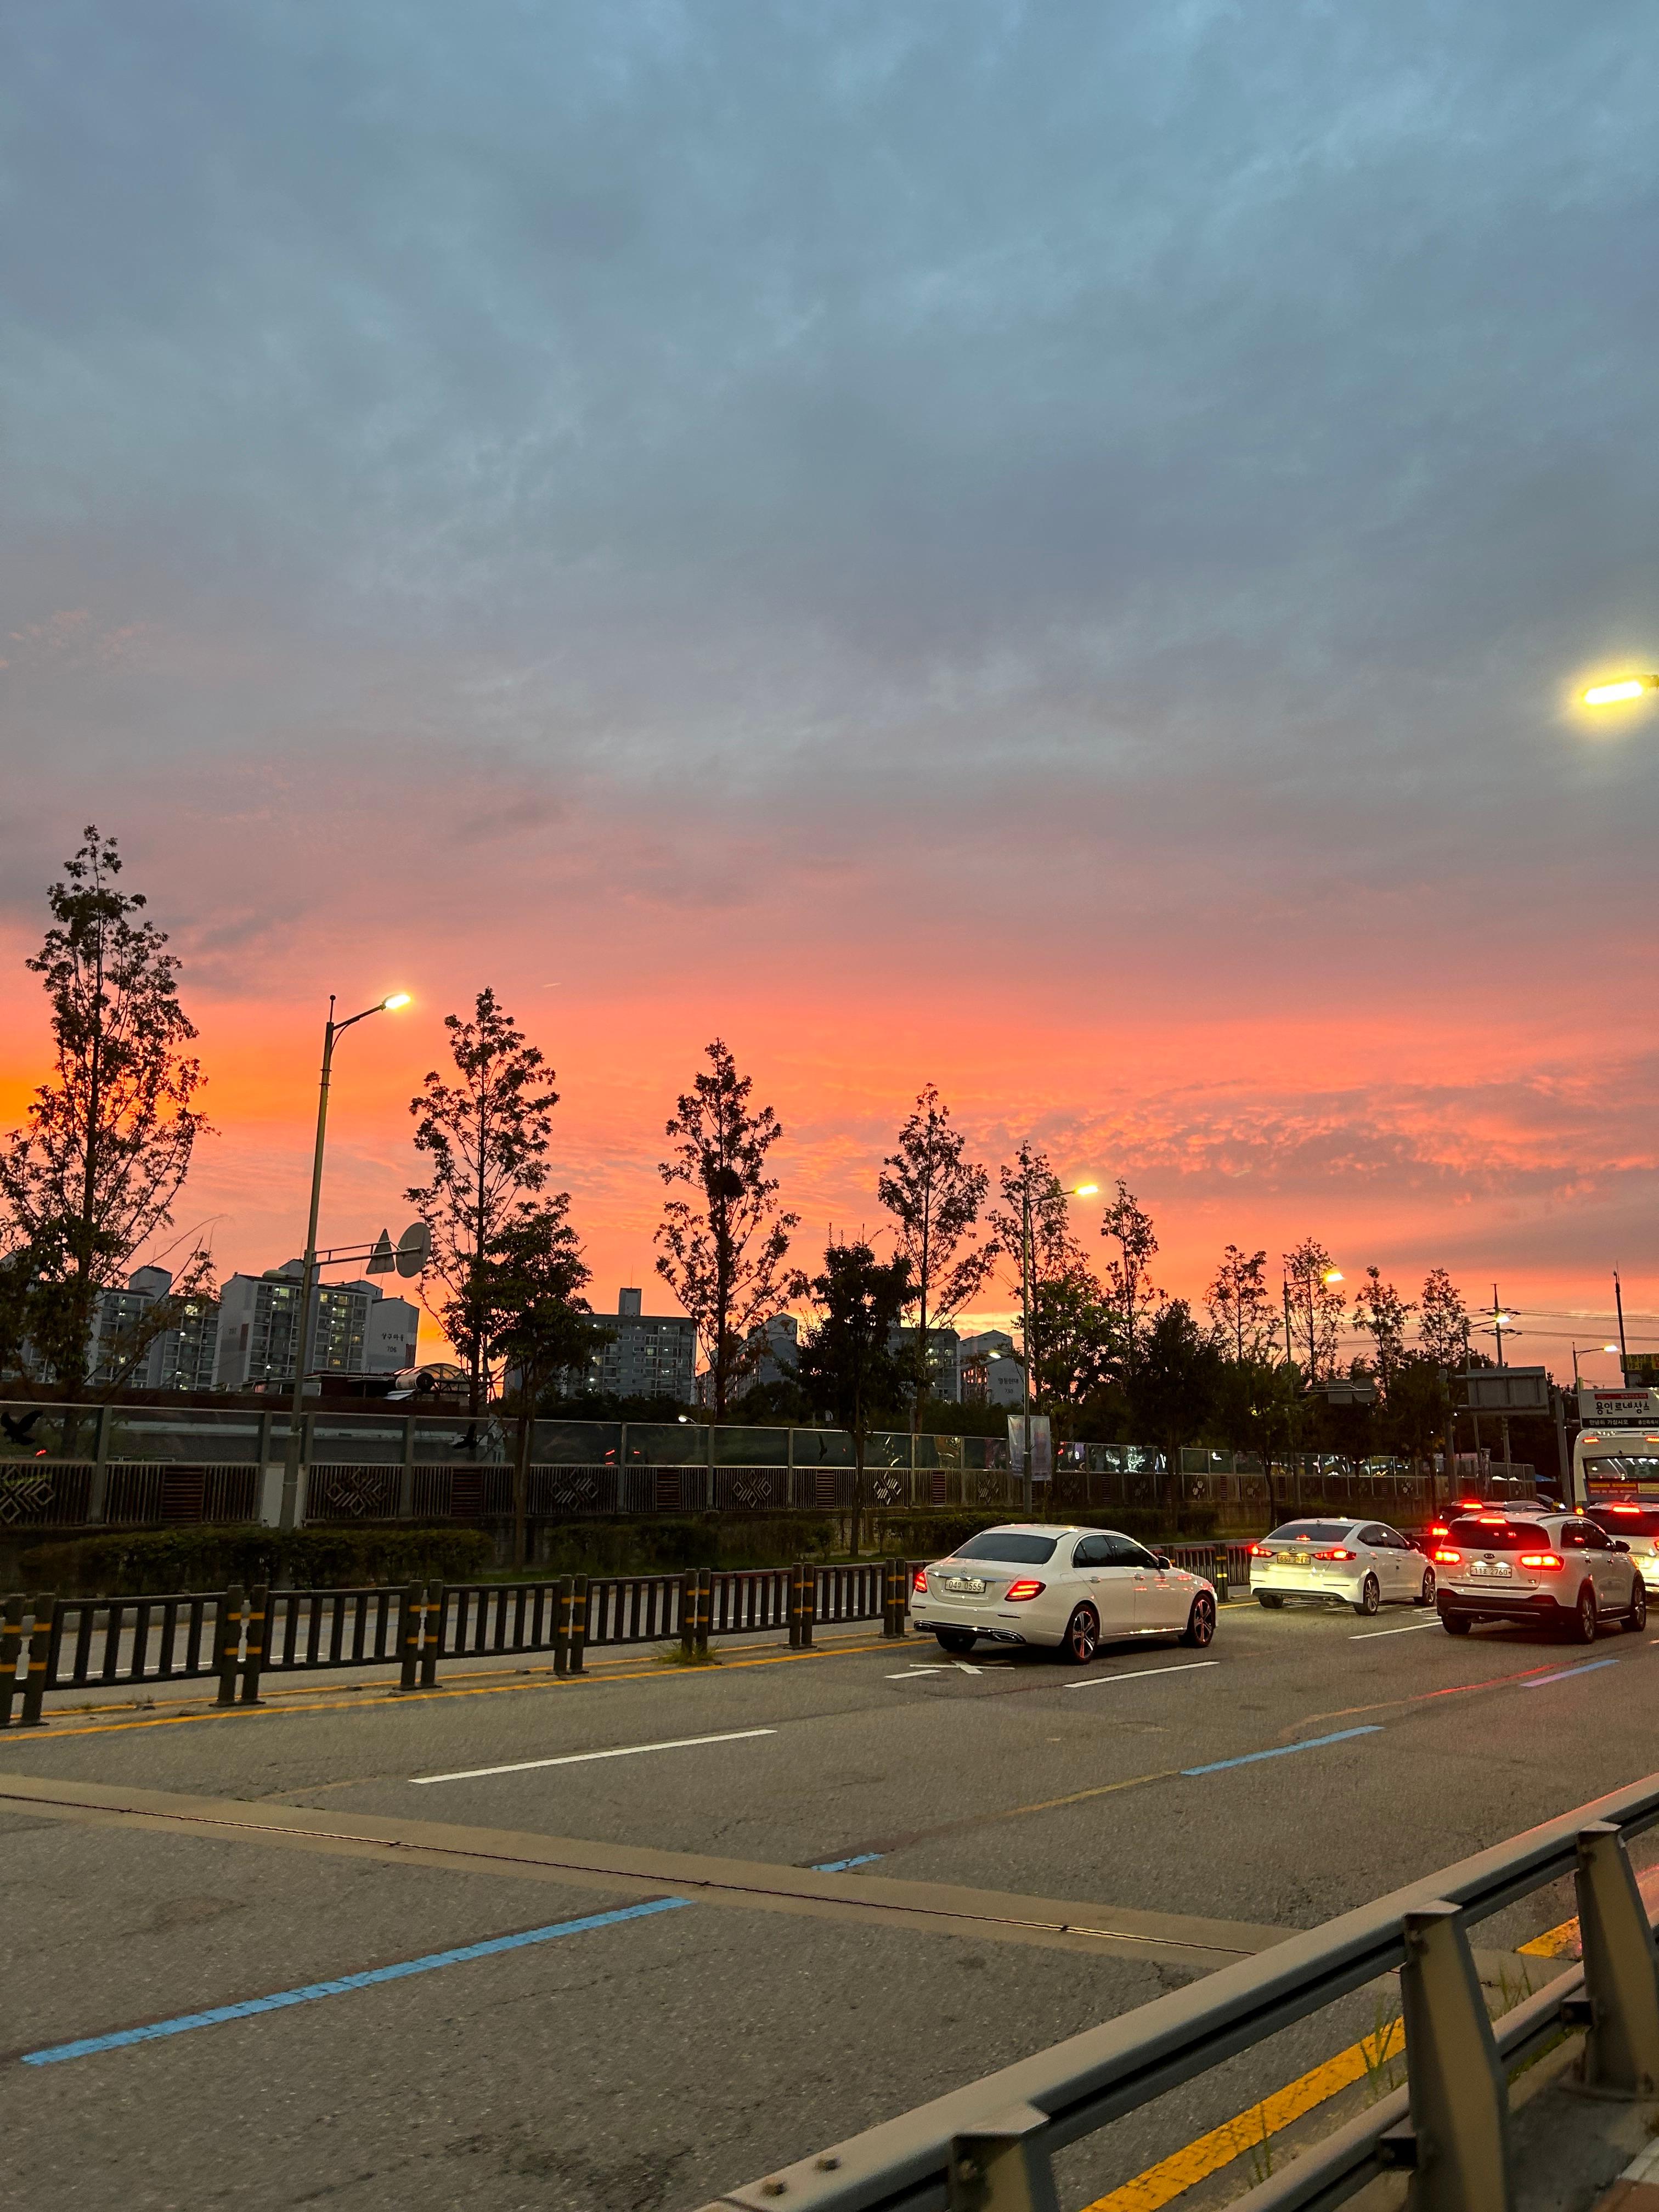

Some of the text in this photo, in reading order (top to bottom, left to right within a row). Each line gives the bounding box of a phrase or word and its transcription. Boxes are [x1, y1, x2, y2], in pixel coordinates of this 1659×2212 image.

[1596, 1401, 1650, 1414] 용인 르네상스
[964, 1582, 981, 1590] 0555
